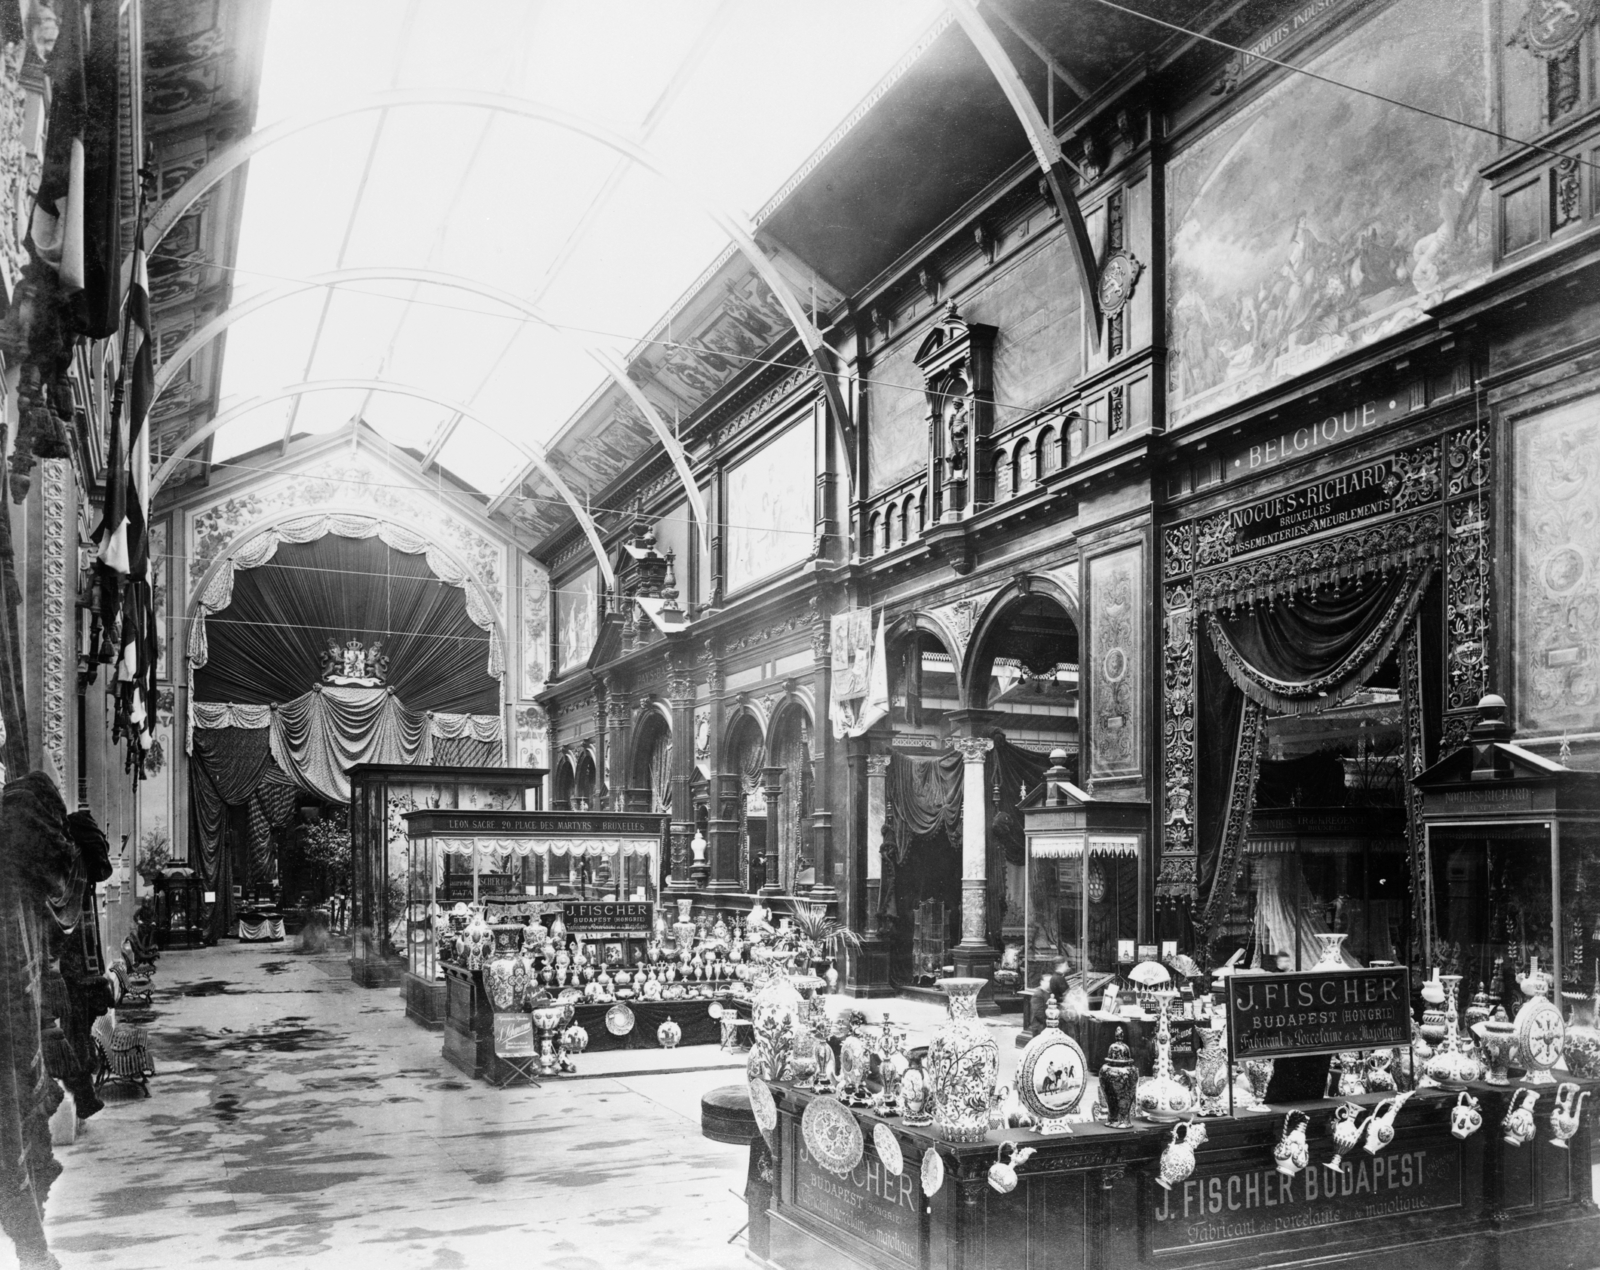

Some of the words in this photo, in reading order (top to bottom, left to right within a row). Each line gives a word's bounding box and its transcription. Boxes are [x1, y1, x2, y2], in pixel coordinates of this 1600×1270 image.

[1249, 400, 1376, 469] BELGIQUE
[1230, 524, 1306, 555] PASSEMENTERIES
[1313, 498, 1391, 532] AMEUBLEMENTS
[1279, 503, 1331, 527] BRUXELLES
[449, 820, 469, 829] LEON
[515, 821, 537, 830] PLACE
[540, 821, 554, 830] DES
[557, 821, 592, 831] MARTYRS
[602, 822, 645, 831] BRUXELLES
[580, 904, 647, 916] FISCHER
[1236, 984, 1260, 1012] J.
[1252, 1011, 1338, 1030] BUDAPEST
[1342, 1005, 1396, 1025] (HONGRIE)
[1294, 1027, 1343, 1046] Porcelaine
[810, 1172, 865, 1210] BUDAPEST
[818, 1158, 916, 1213] CHER
[1183, 1167, 1294, 1218] FISCHER
[1305, 1151, 1427, 1201] BUDAPEST
[1187, 1219, 1256, 1244] Fabricant
